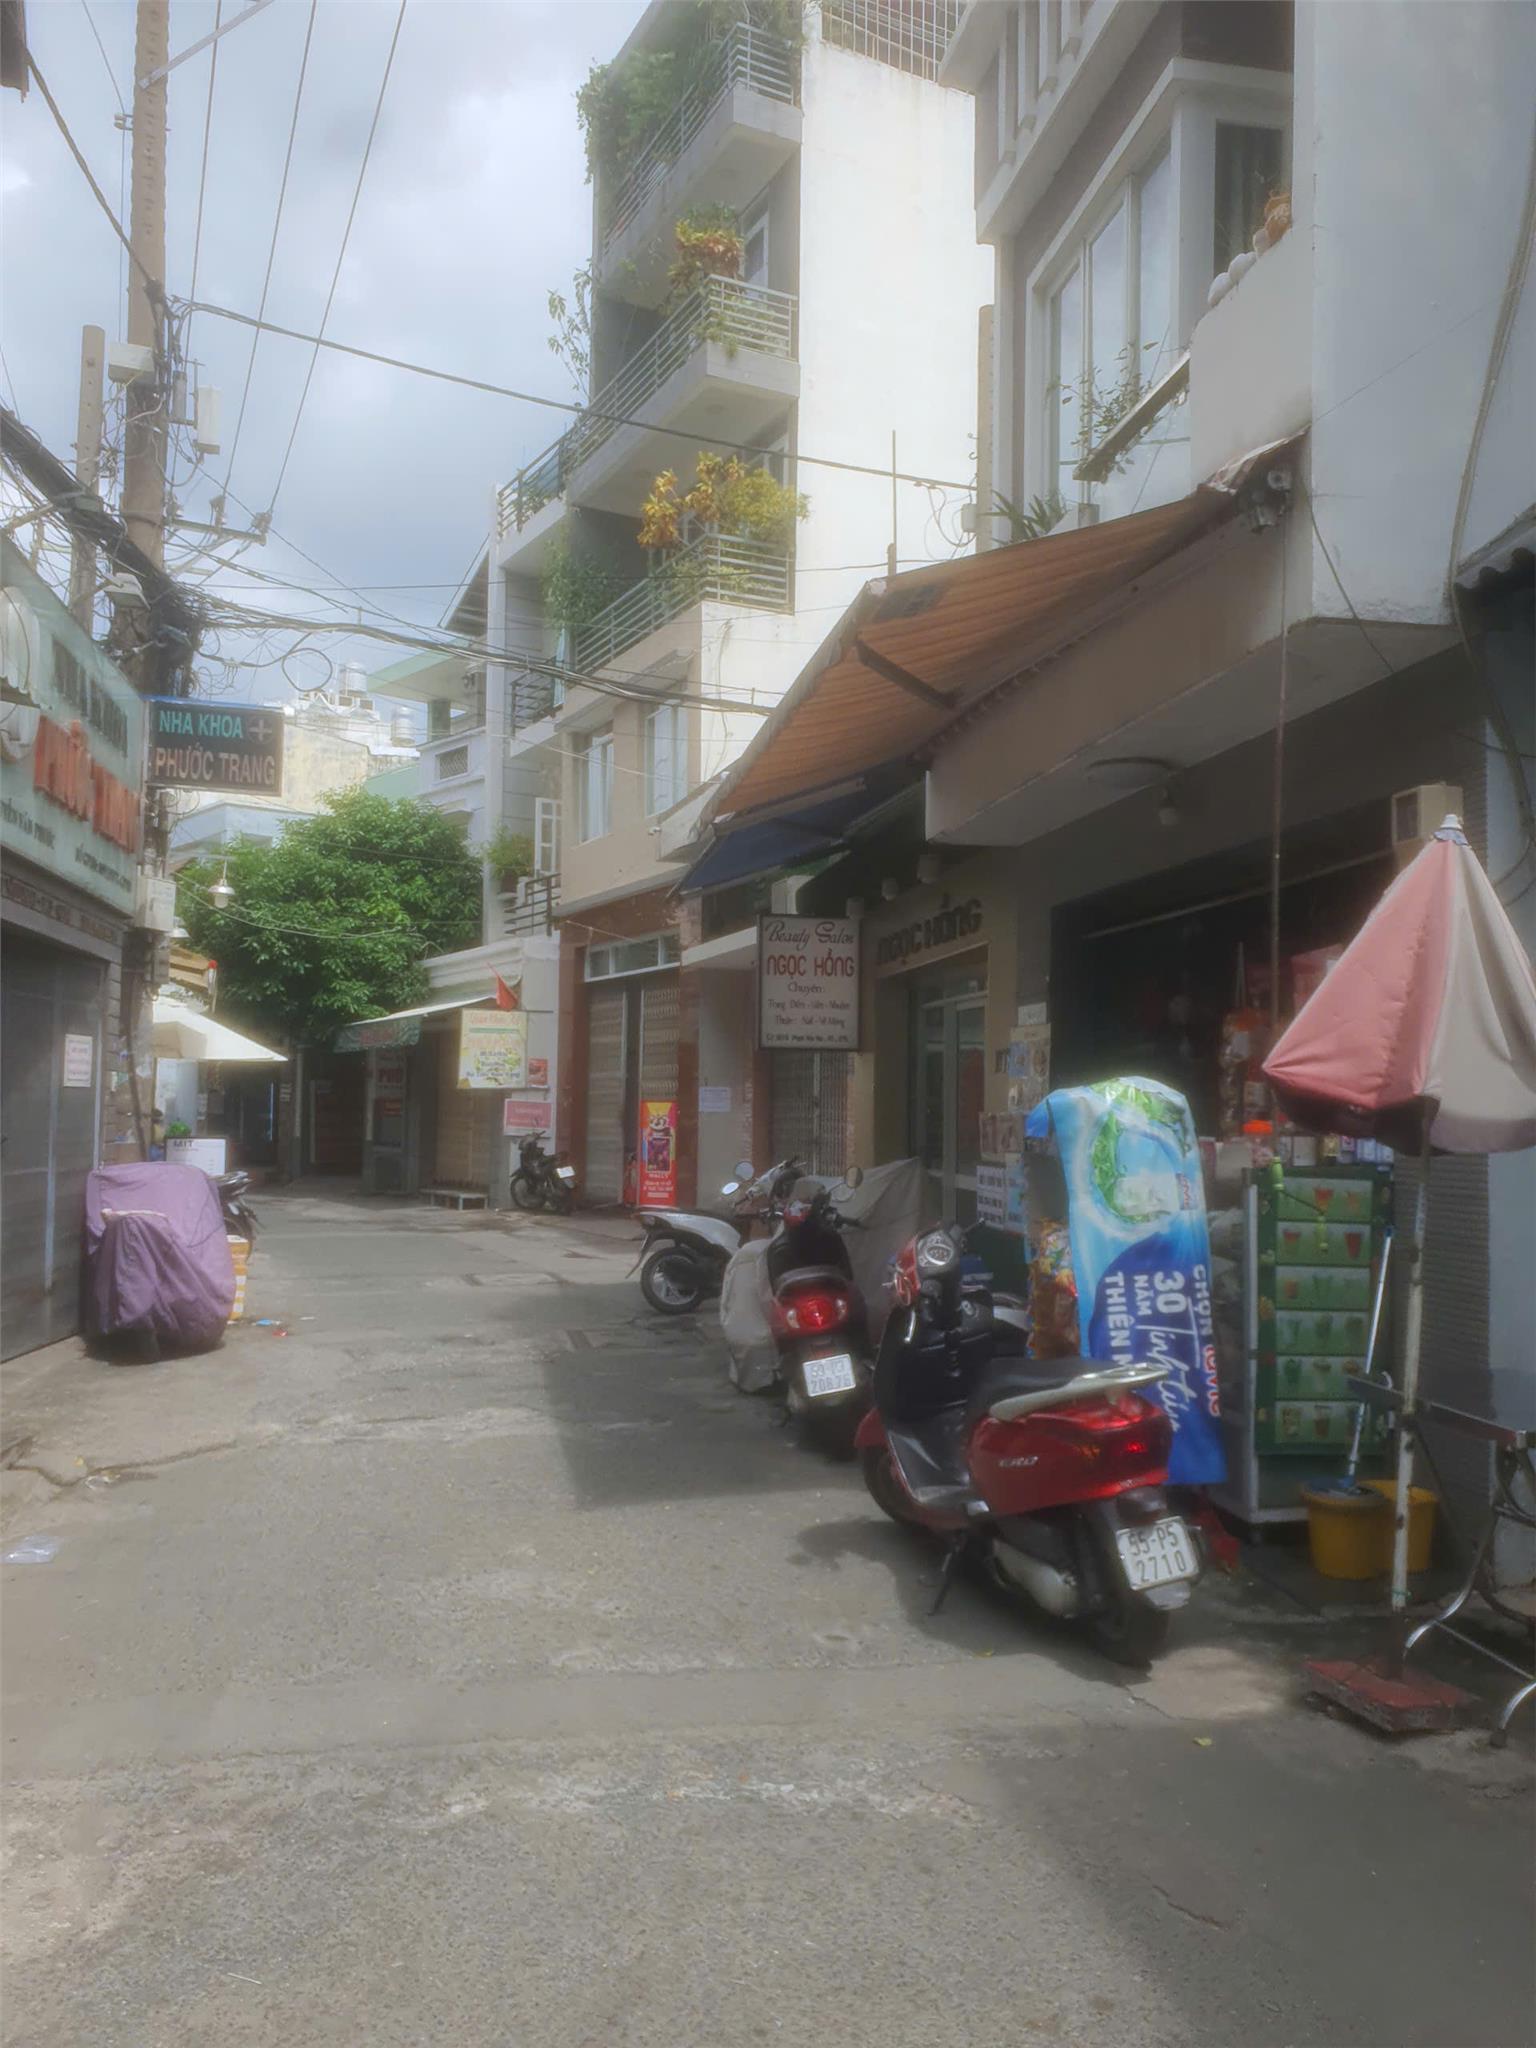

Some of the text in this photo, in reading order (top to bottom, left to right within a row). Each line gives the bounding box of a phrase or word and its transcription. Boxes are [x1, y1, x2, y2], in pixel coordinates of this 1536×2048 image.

[159, 710, 244, 739] NHA KHOA
[155, 742, 275, 785] PHƯỚC TRANG
[765, 920, 810, 951] Beauty
[767, 955, 807, 980] NGỌC
[1105, 1271, 1136, 1348] THIÊN
[1133, 1274, 1155, 1316] NĂM
[1154, 1271, 1187, 1314] 30
[1193, 1264, 1213, 1336] CHỌN
[1136, 1550, 1186, 1583] 2710
